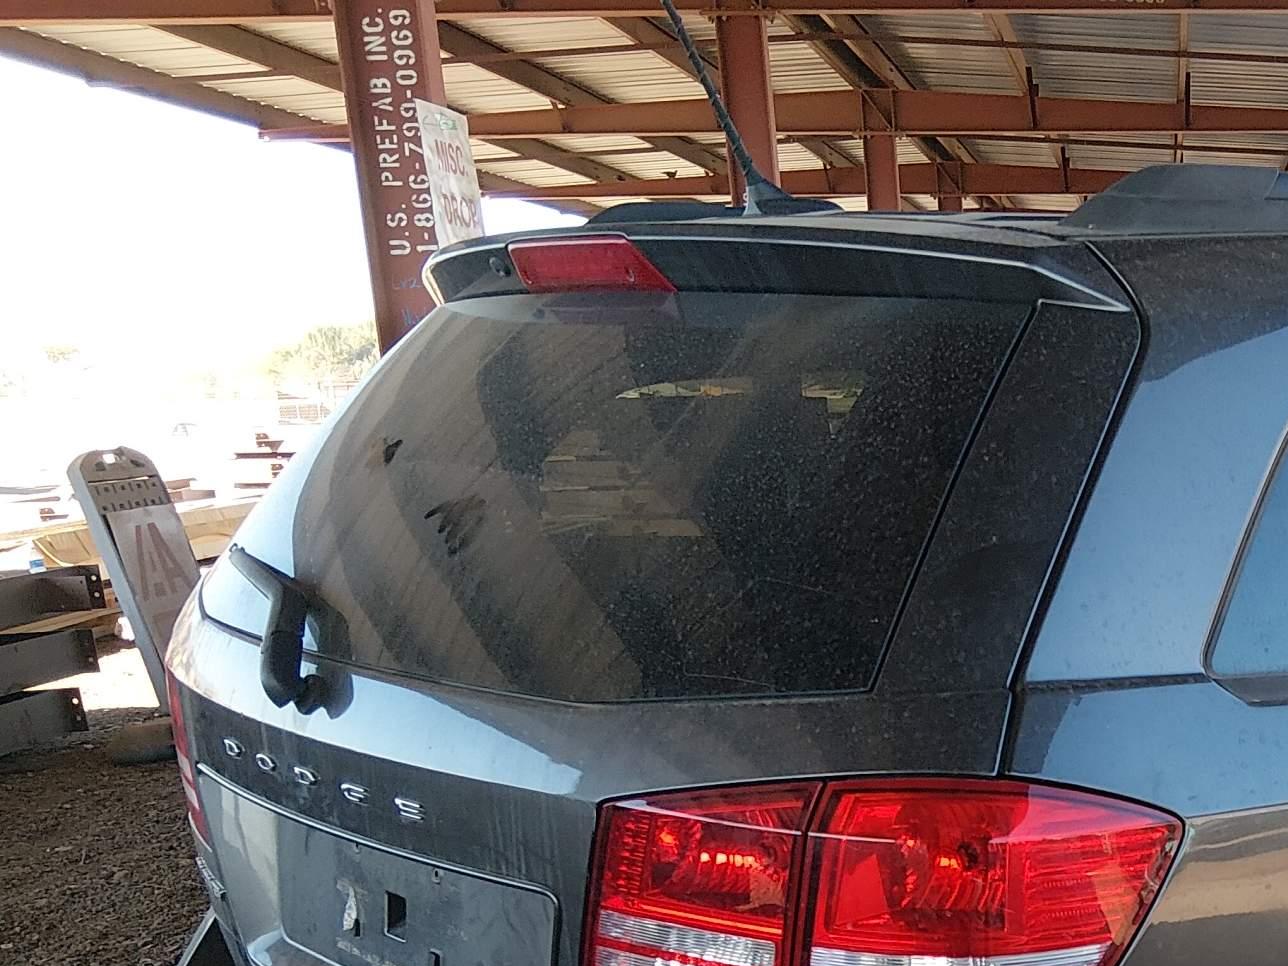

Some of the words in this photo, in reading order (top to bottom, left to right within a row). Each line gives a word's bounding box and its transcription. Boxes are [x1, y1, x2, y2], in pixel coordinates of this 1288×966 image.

[361, 7, 388, 62] INC.
[369, 76, 404, 187] PREFAB
[386, 203, 412, 256] U.S.
[441, 191, 478, 229] DROP
[222, 738, 426, 823] DODGE
